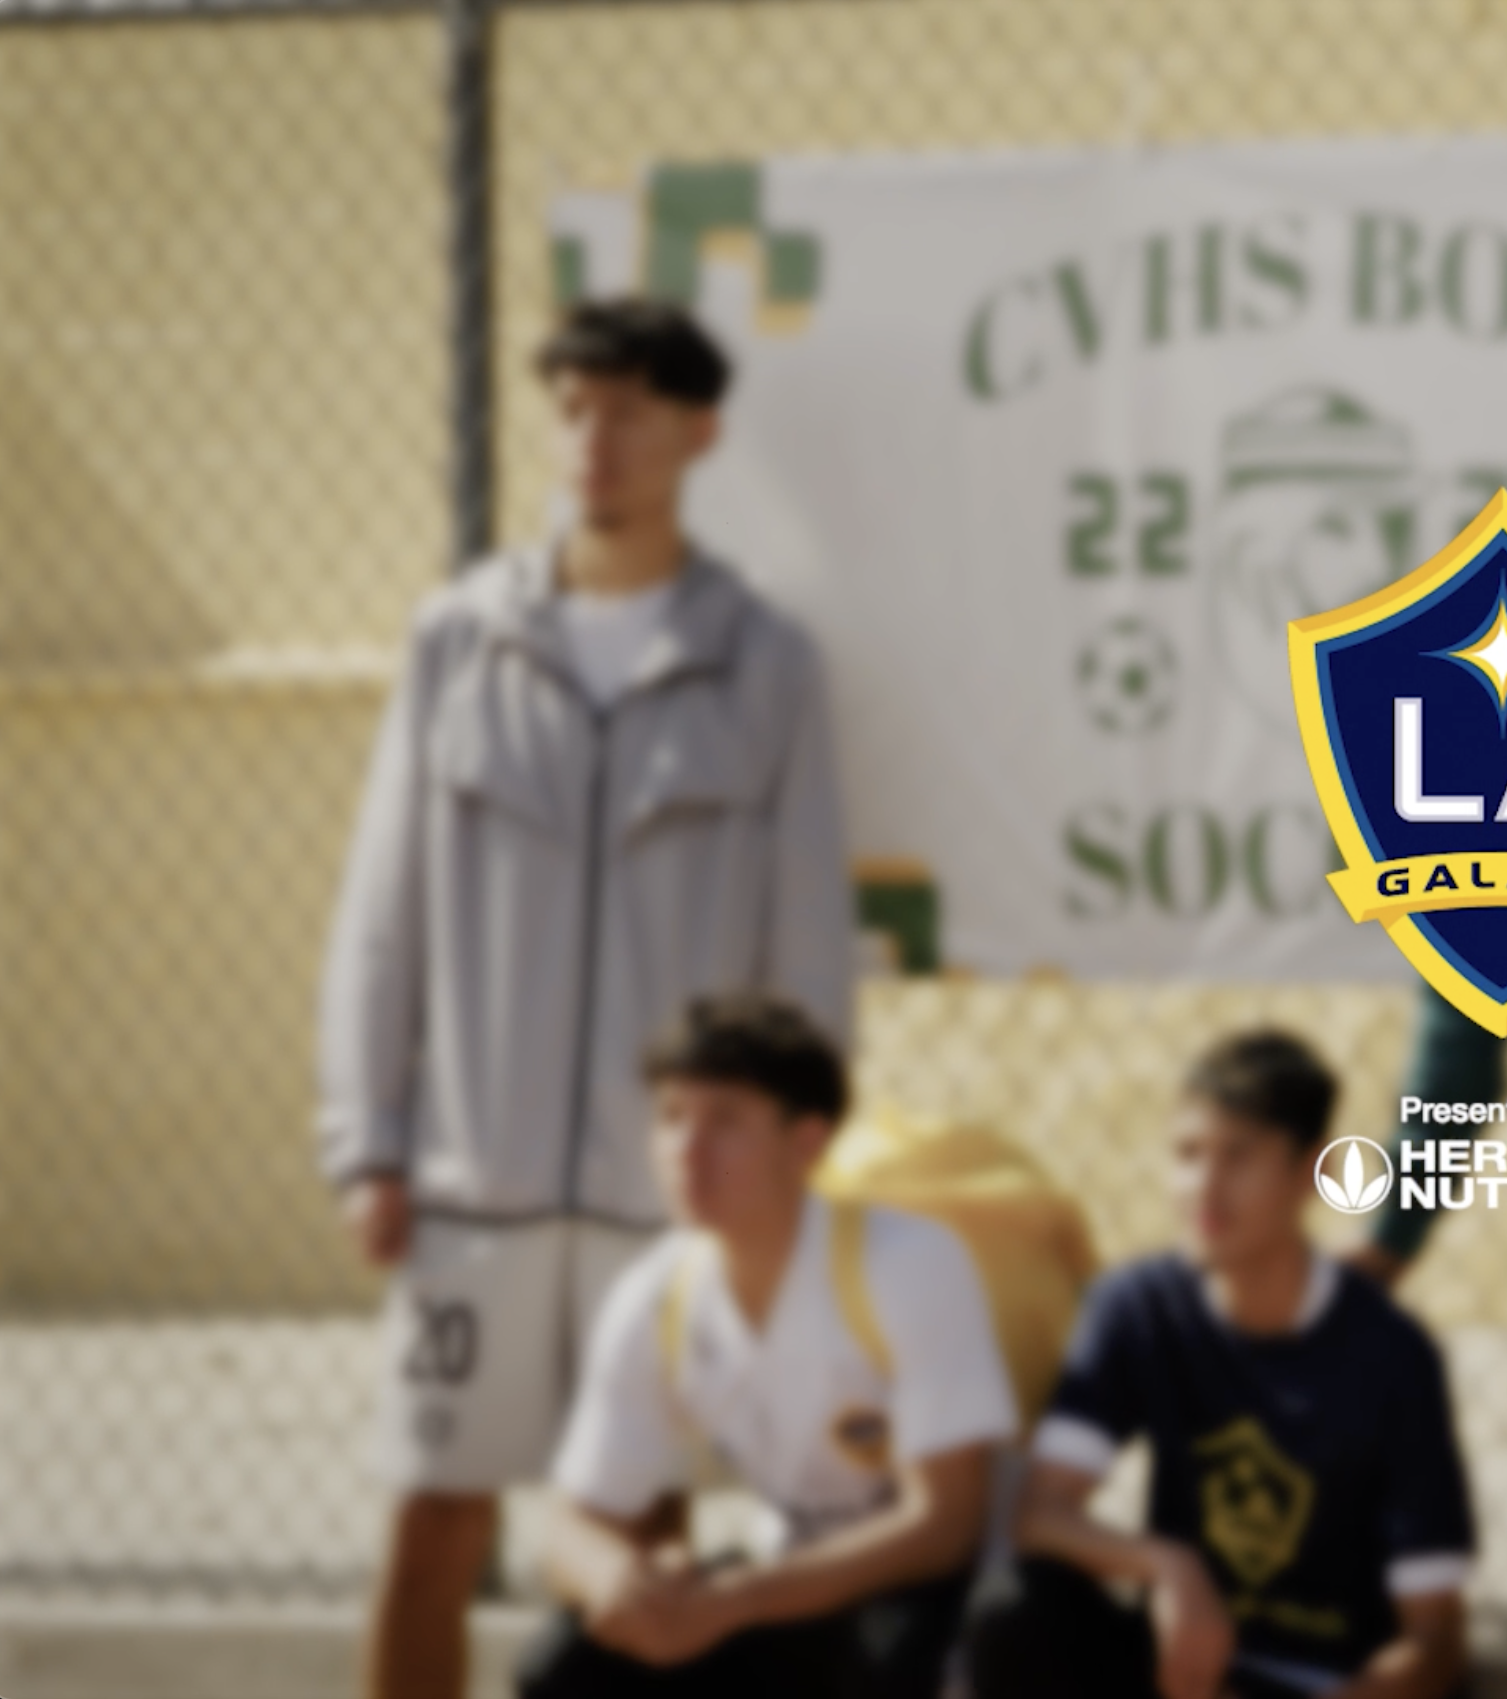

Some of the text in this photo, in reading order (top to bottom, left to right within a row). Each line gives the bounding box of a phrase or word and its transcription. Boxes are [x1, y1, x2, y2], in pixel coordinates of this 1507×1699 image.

[958, 208, 1310, 403] CVHS
[1064, 470, 1193, 578] 22
[1060, 802, 1345, 922] SOC
